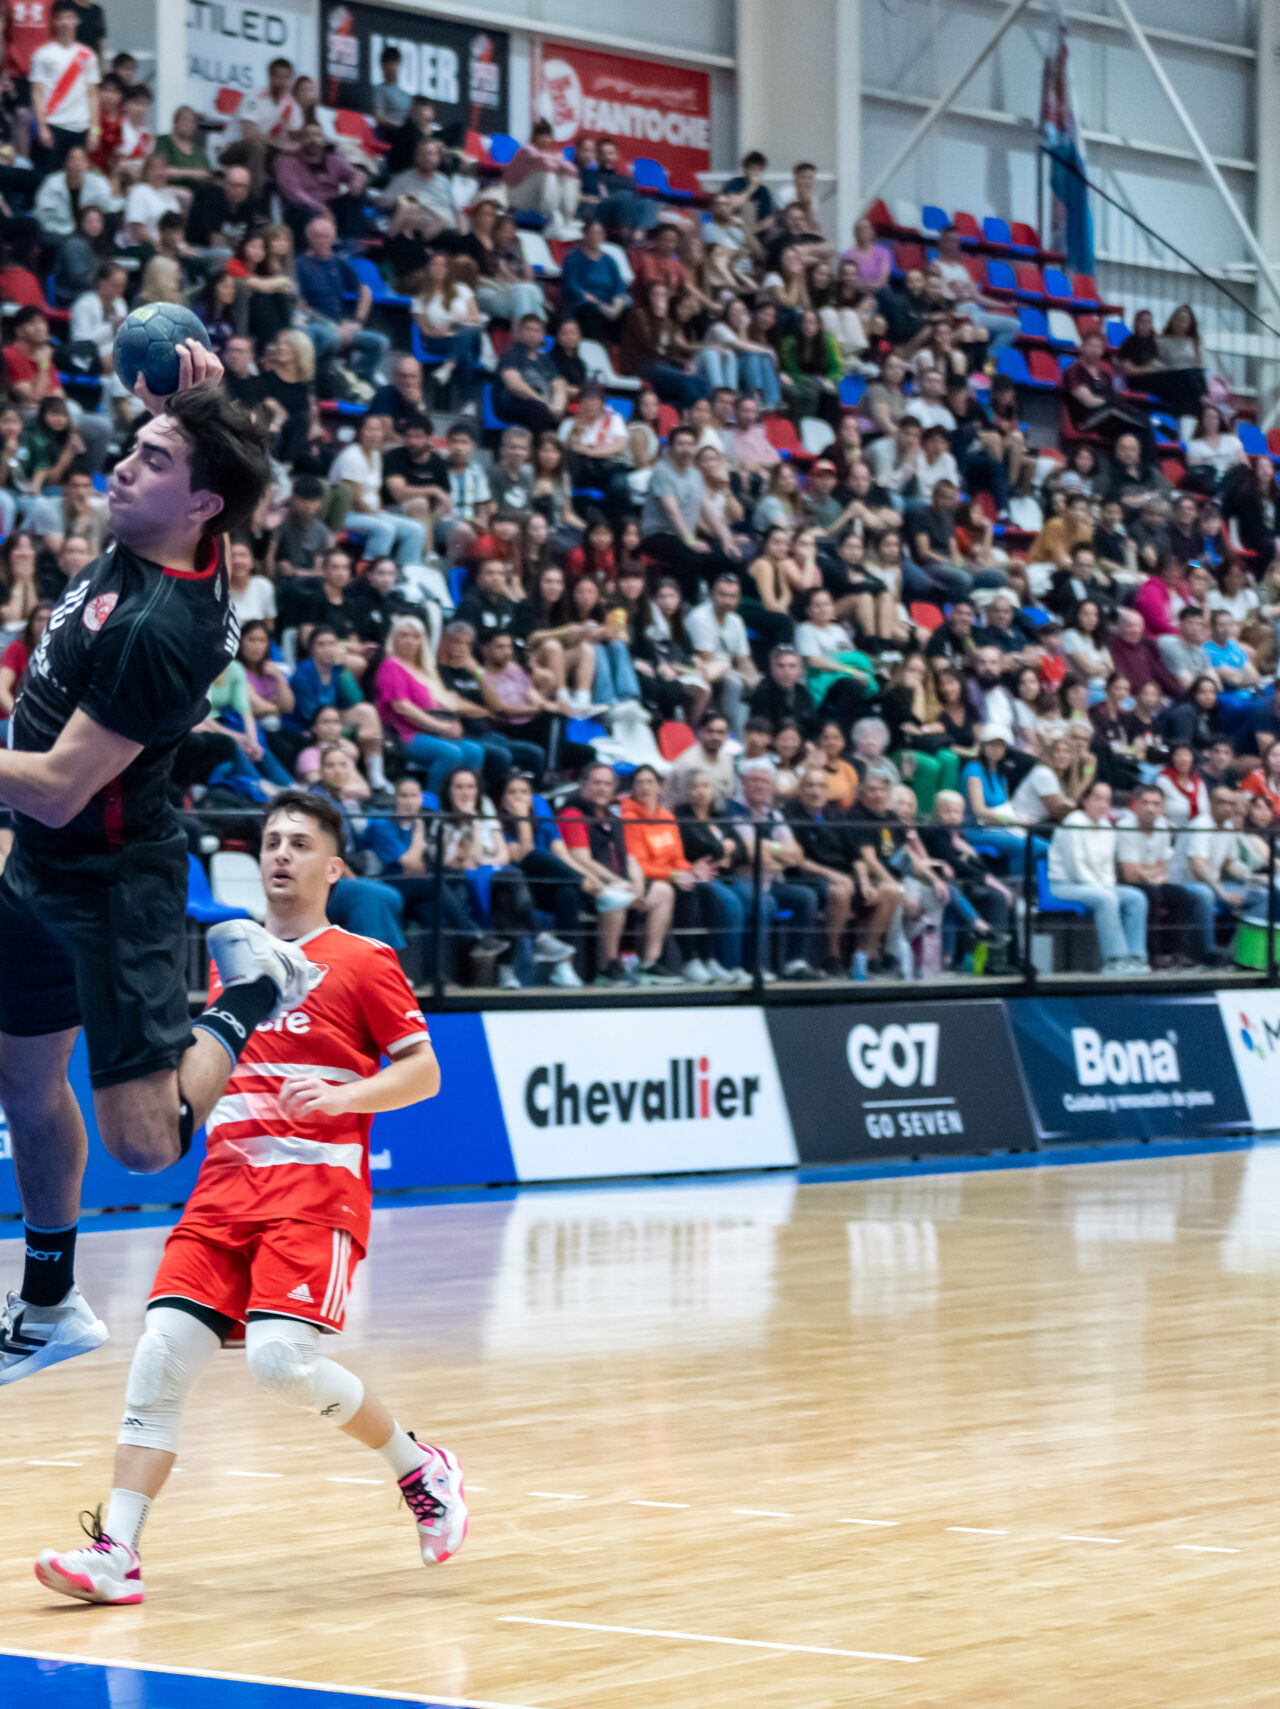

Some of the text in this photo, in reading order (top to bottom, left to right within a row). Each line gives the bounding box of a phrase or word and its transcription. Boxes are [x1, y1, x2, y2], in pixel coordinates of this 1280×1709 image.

[582, 96, 711, 150] FANTOCHE
[846, 1022, 940, 1089] GO7
[1071, 1026, 1181, 1086] Bona
[524, 1056, 760, 1128] Chevallier
[865, 1110, 964, 1139] GO SEVEN
